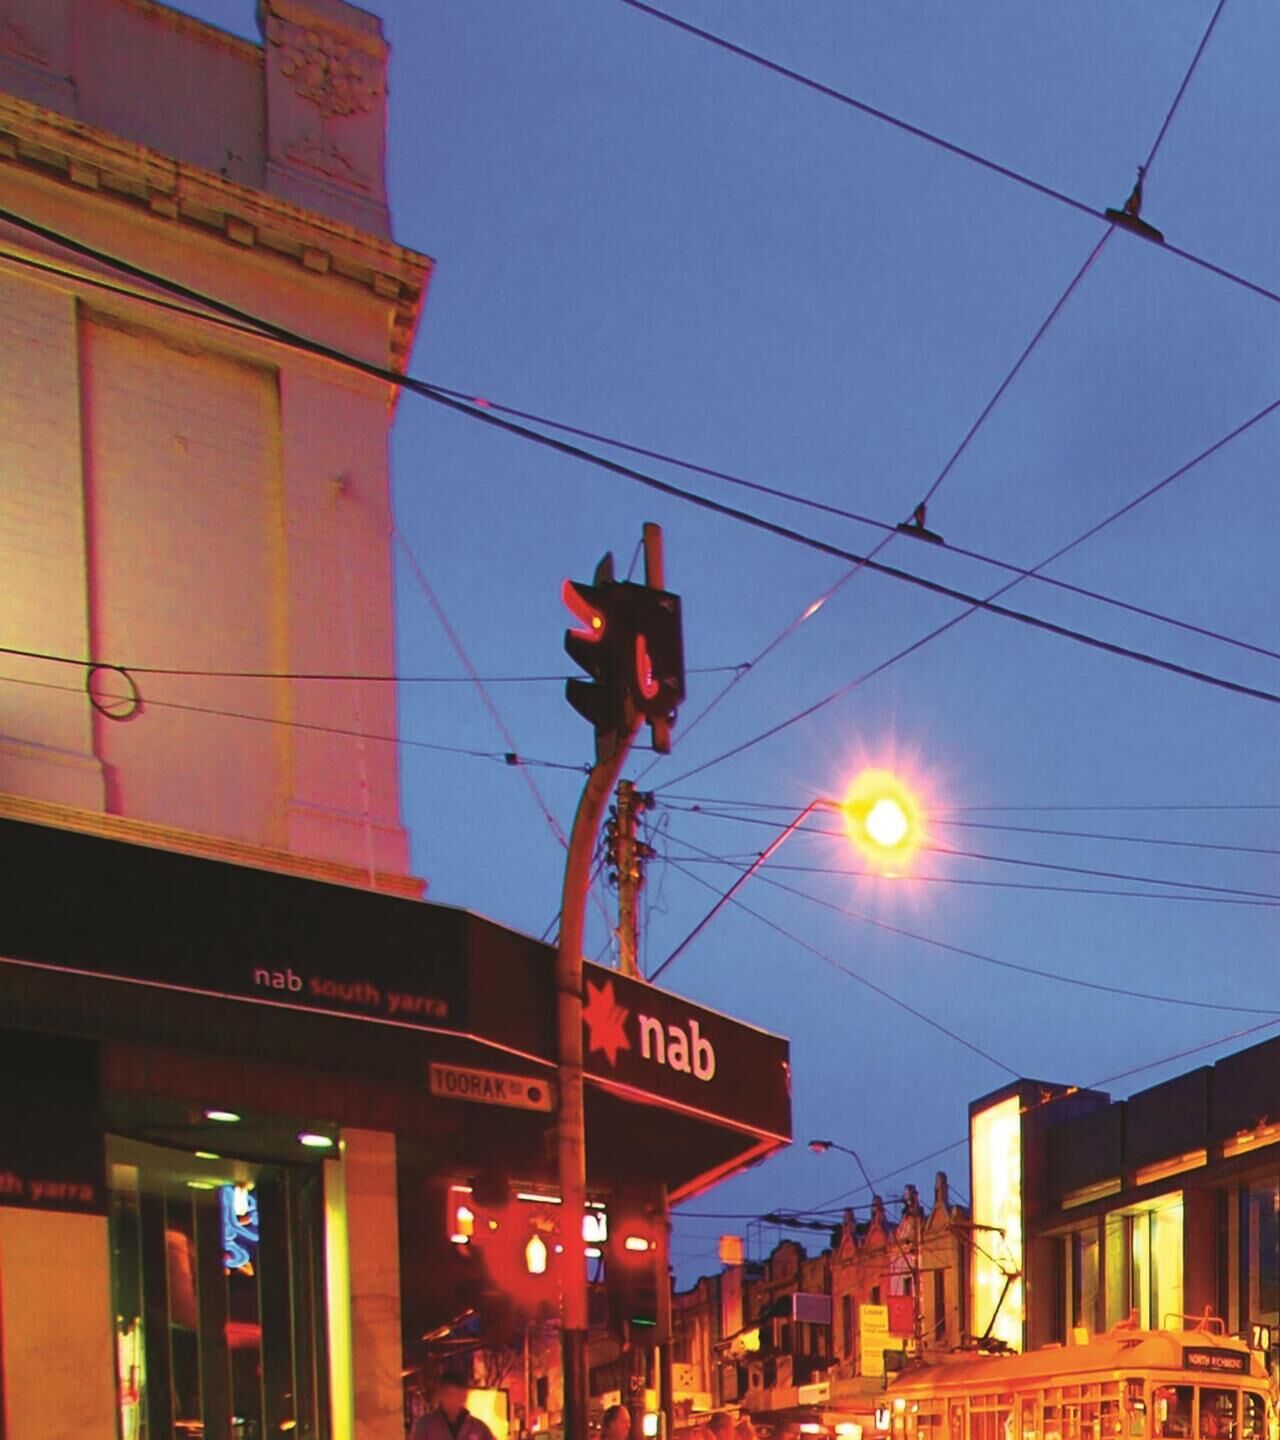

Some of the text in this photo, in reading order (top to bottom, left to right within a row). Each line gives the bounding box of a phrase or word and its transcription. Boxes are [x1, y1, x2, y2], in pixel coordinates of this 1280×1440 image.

[254, 968, 449, 1019] nab south yarra
[638, 1014, 716, 1081] nab
[433, 1069, 507, 1100] TOORAK
